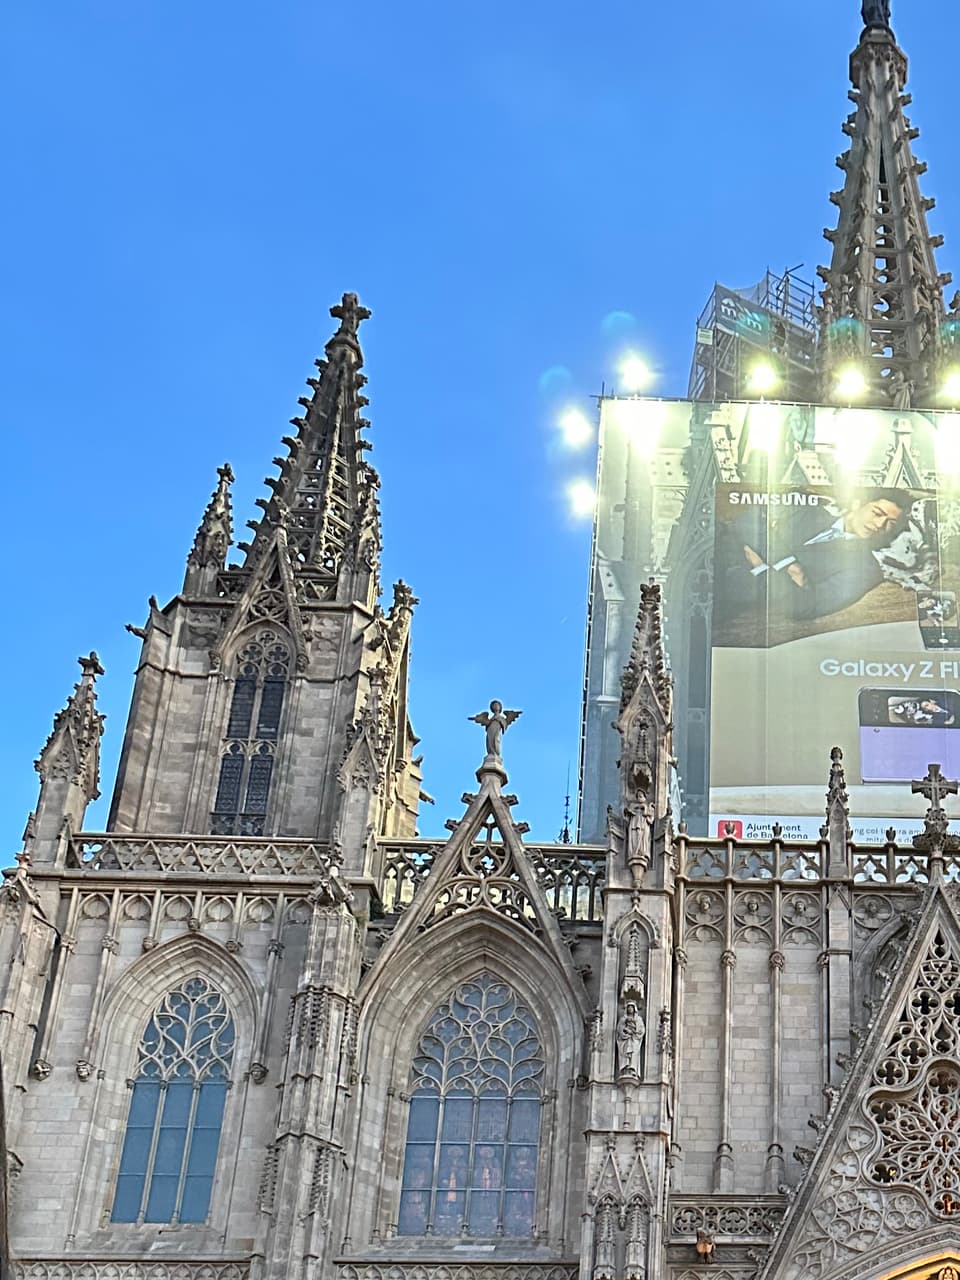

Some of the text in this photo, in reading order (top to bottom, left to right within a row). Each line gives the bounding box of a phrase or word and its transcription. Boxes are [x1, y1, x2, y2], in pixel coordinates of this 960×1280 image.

[729, 492, 819, 506] SAMSUNG
[819, 658, 915, 682] Galaxy
[919, 661, 934, 678] Z
[746, 823, 801, 832] Ajuntent
[761, 832, 808, 840] Baelona
